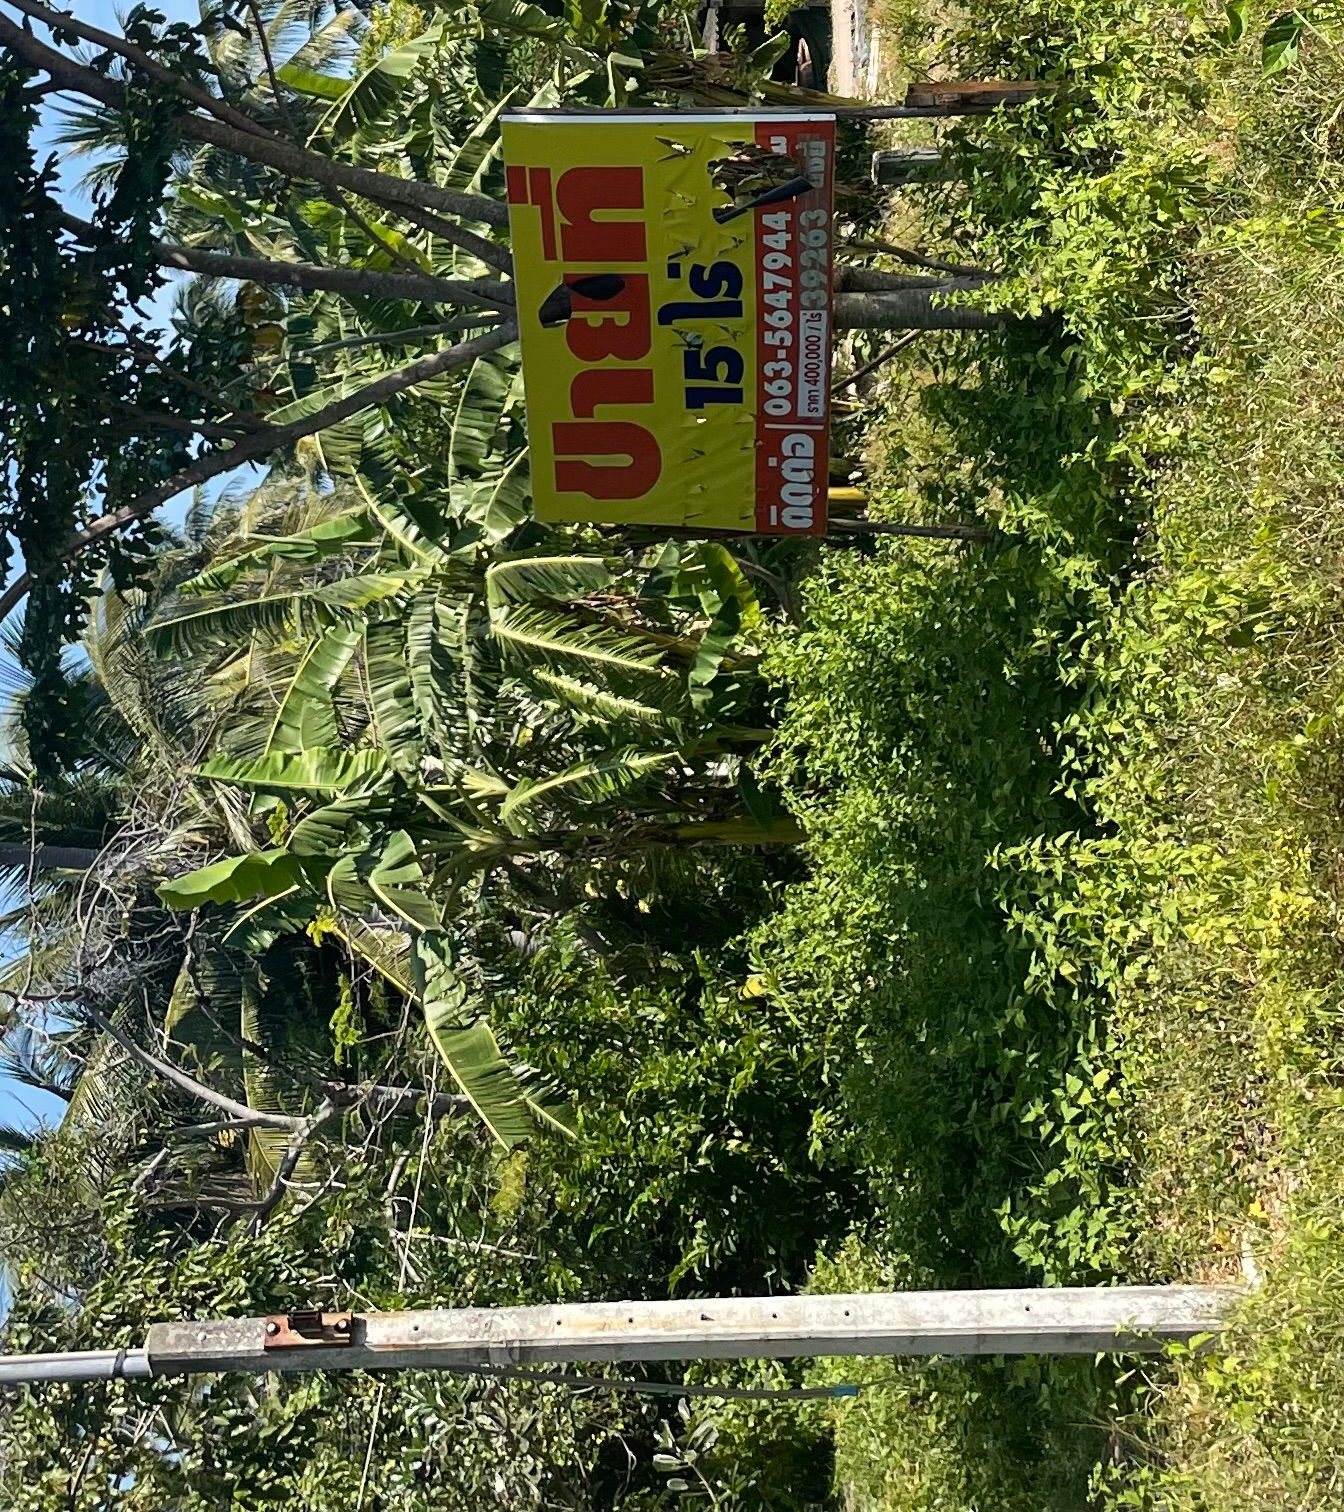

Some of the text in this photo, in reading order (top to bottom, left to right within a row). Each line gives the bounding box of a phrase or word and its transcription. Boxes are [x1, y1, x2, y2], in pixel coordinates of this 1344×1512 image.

[506, 166, 661, 499] ขายที่
[657, 262, 743, 409] 15 ไร่
[763, 212, 792, 416] 063-5647944
[804, 335, 822, 386] 400,000
[808, 390, 819, 413] ราคา
[768, 433, 814, 528] ติดต่อ
